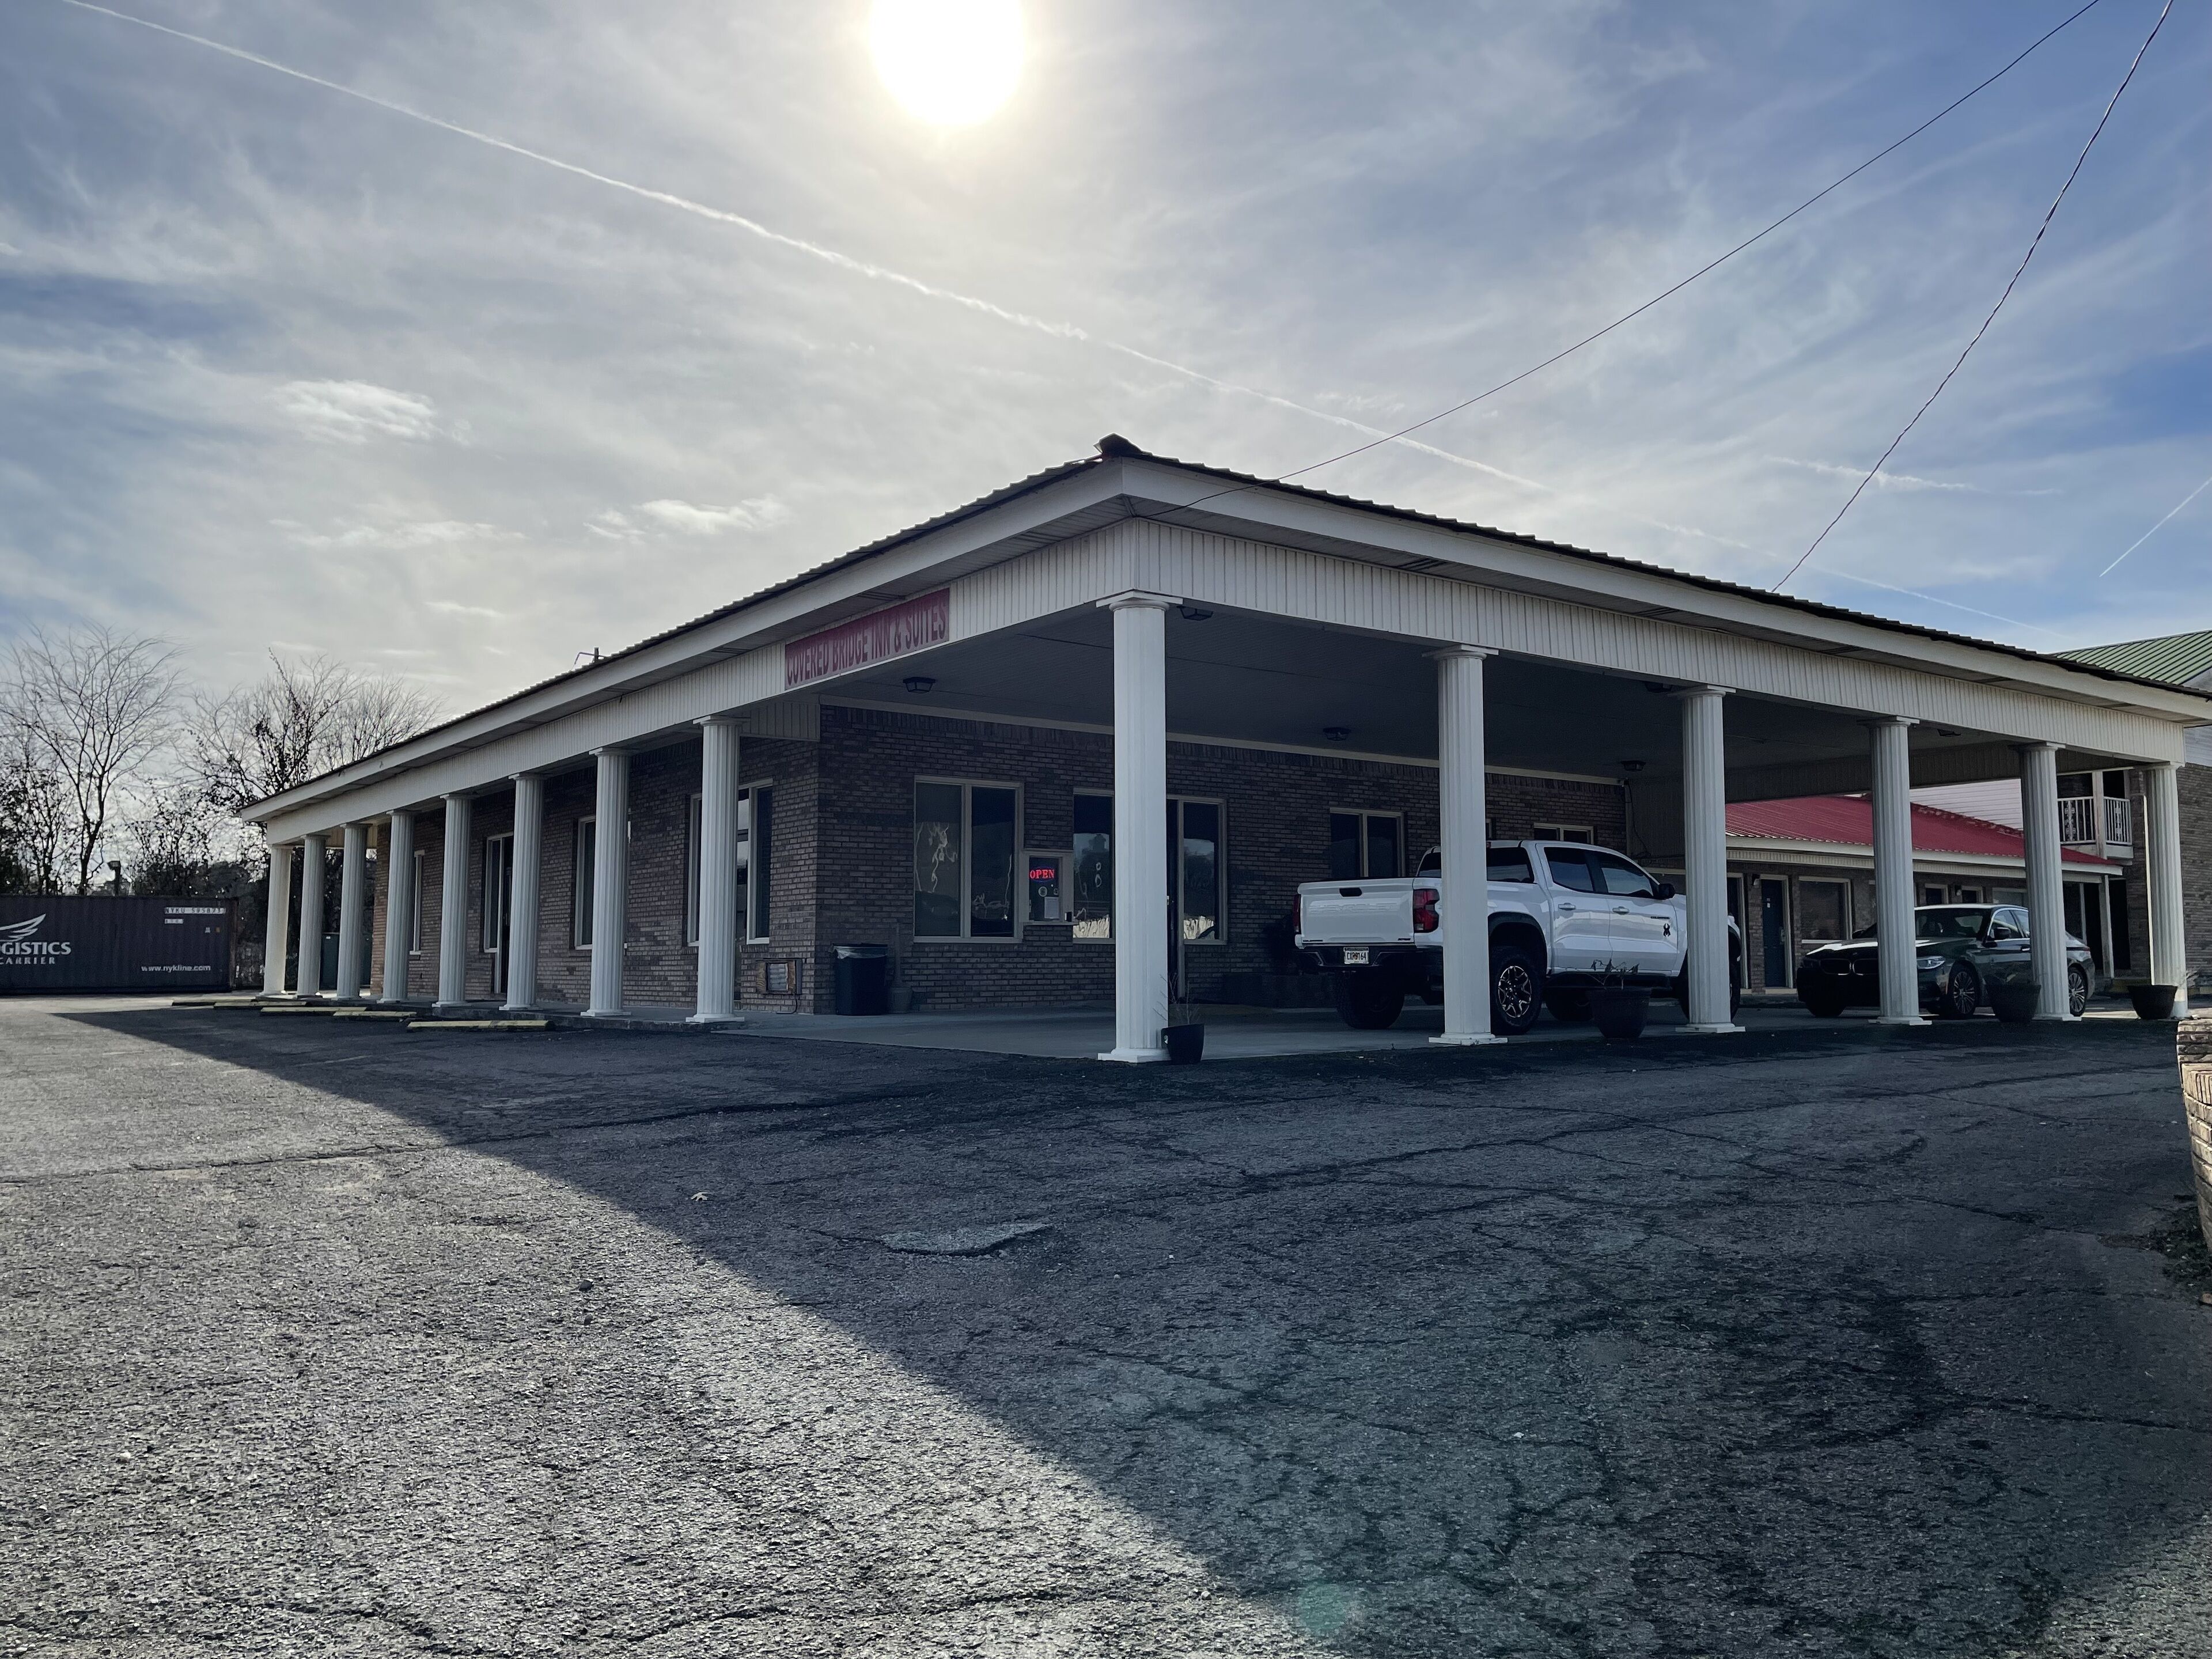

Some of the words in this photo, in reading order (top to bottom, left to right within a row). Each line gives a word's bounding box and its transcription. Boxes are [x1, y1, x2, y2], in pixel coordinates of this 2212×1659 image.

[787, 641, 830, 686] COVERED
[832, 623, 868, 672] BRIDGE
[871, 613, 891, 660] INN
[894, 613, 902, 653] &
[905, 600, 946, 650] SUITES
[1029, 869, 1055, 879] OPEN
[0, 942, 71, 955] GISTICS
[141, 965, 211, 973] www.nykline.com
